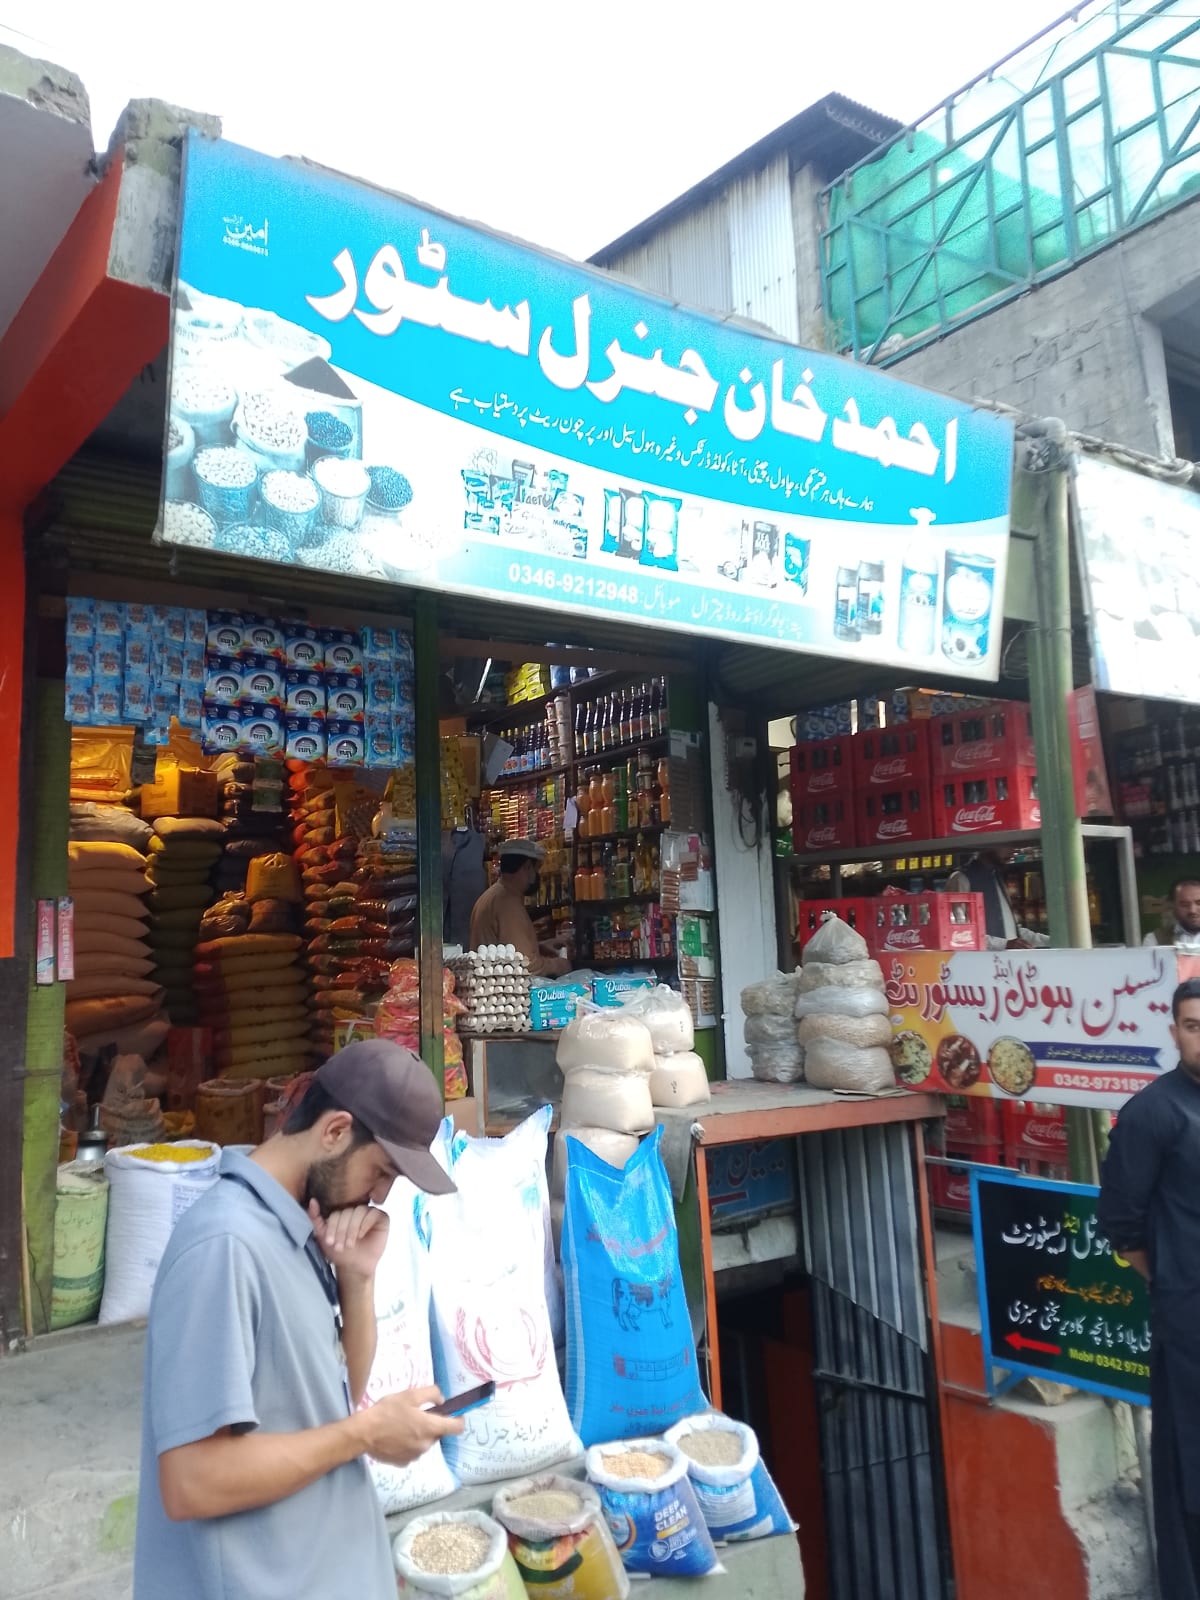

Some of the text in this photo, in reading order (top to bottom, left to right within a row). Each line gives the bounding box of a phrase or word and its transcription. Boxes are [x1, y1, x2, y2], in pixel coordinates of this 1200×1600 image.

[305, 227, 959, 485] احمد خان جنرل سٹور
[508, 562, 639, 605] 0346-9212948
[654, 1500, 680, 1522] DEEP
[655, 1505, 689, 1531] CLEAN
